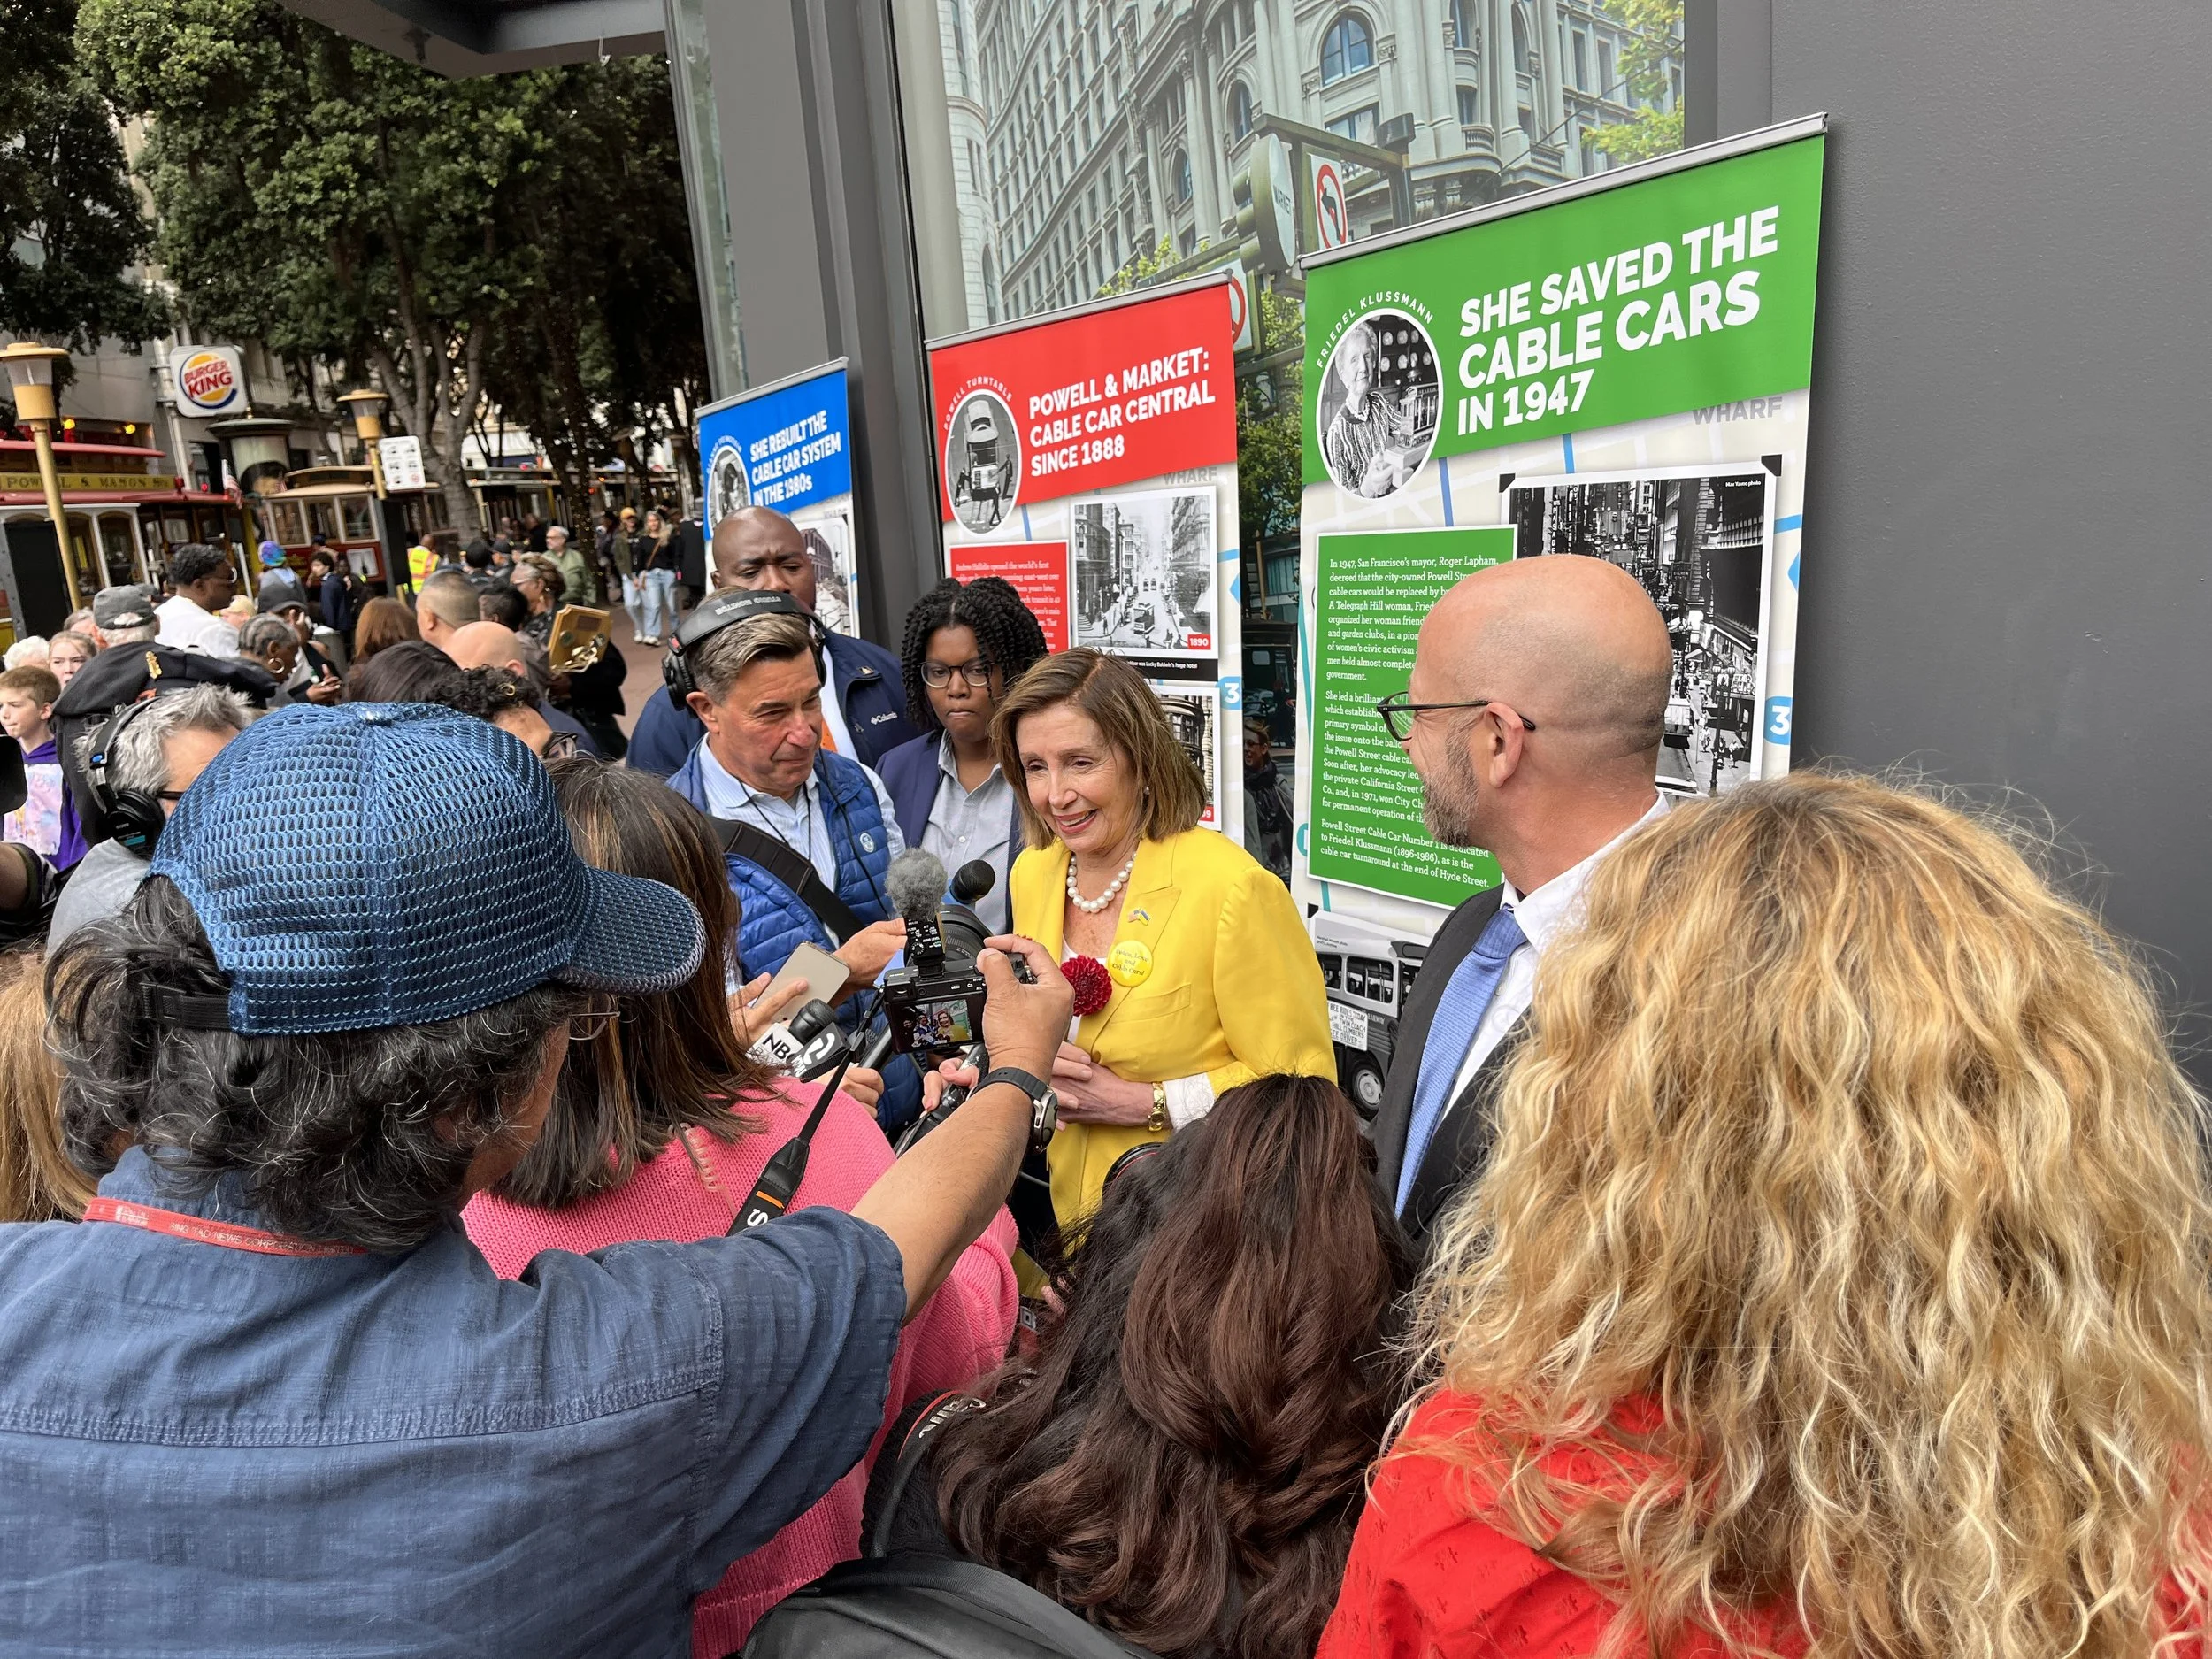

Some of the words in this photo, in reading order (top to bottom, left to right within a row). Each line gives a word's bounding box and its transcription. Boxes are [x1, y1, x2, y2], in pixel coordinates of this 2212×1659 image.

[1460, 281, 1531, 338] SHE
[1540, 242, 1673, 315] SAVED
[1682, 206, 1779, 274] THE
[1317, 309, 1356, 368] FRIEDEL
[1360, 291, 1433, 324] KLUSSMANN
[1458, 310, 1603, 388] CABLE
[1616, 270, 1760, 351] CARS
[184, 360, 228, 384] BURGER
[188, 372, 233, 398] KING
[1029, 379, 1102, 419] POWELL
[1104, 374, 1118, 398] &
[1123, 347, 1209, 394] MARKET:
[944, 388, 965, 430] POWELL
[966, 377, 1012, 402] TURNTABLE
[1458, 392, 1493, 435] IN
[1503, 369, 1594, 426] 1947
[1693, 397, 1782, 425] WHARF
[1030, 414, 1081, 448] CABLE
[1085, 404, 1123, 433] CAR
[1125, 380, 1216, 423] CENTRAL
[750, 438, 769, 462] SHE
[770, 419, 806, 456] REBUILT
[808, 410, 827, 436] THE
[753, 458, 782, 486] CABLE
[782, 449, 801, 473] CAR
[802, 432, 841, 465] SYSTEM
[1031, 445, 1078, 477] SINCE
[1081, 434, 1125, 465] 1888
[1164, 468, 1217, 485] WHARF
[753, 488, 764, 506] IN
[764, 481, 785, 505] THE
[785, 473, 812, 498] 1980s
[1330, 559, 1337, 568] In
[1340, 560, 1356, 569] 1947,
[1371, 557, 1409, 567] Francisco's
[1411, 558, 1437, 570] mayor,
[1439, 557, 1462, 568] Roger
[1330, 573, 1356, 582] decreed
[1372, 572, 1383, 581] the
[1385, 572, 1425, 583] city-owned
[1427, 572, 1453, 580] Powell
[1329, 588, 1348, 596] cable
[1396, 588, 1427, 600] replaced
[1430, 587, 1439, 597] by
[1336, 601, 1368, 611] Telegraph
[1385, 603, 1413, 612] woman,
[1328, 617, 1360, 626] organized
[1328, 628, 1340, 637] and
[1342, 630, 1363, 639] garden
[1365, 629, 1386, 640] clubs,
[1364, 644, 1381, 653] civic
[1357, 657, 1380, 667] almost
[1327, 671, 1366, 680] government.
[1225, 683, 1240, 703] 3
[1326, 690, 1337, 700] She
[1339, 692, 1348, 701] led
[1355, 694, 1384, 703] brilliant
[1325, 705, 1344, 714] which
[1325, 719, 1349, 729] primary
[1351, 723, 1377, 733] symbol
[1379, 724, 1387, 733] of
[1770, 705, 1791, 736] 3
[1335, 733, 1352, 742] issue
[1372, 738, 1383, 747] the
[1335, 746, 1356, 757] Powell
[1359, 749, 1380, 760] Street
[1382, 752, 1401, 763] cable
[1324, 759, 1339, 768] Soon
[1340, 761, 1358, 772] after,
[1360, 763, 1372, 772] her
[1374, 767, 1406, 779] advocacy
[1334, 775, 1358, 787] private
[1361, 778, 1394, 790] California
[1396, 784, 1419, 795] Street
[1323, 786, 1334, 795] Co.,
[1336, 789, 1350, 799] and,
[1352, 790, 1359, 799] in
[1361, 792, 1379, 803] 1971,
[1395, 796, 1409, 809] City
[1333, 802, 1371, 814] permanent
[1372, 808, 1405, 821] operation
[1407, 810, 1415, 821] of
[1322, 819, 1342, 831] Powell
[1345, 824, 1366, 835] Street
[1368, 827, 1386, 839] Cable
[1388, 831, 1401, 841] Car
[1402, 834, 1433, 848] Number
[1329, 834, 1353, 846] Friedel
[1356, 839, 1392, 854] Klussmann
[1394, 846, 1440, 864] (1896-1986),
[1442, 856, 1450, 865] as
[1452, 857, 1459, 867] is
[1461, 859, 1473, 870] the
[1321, 847, 1338, 856] cable
[1340, 850, 1351, 859] car
[1353, 853, 1390, 867] turnaround
[1401, 861, 1413, 872] the
[1415, 865, 1428, 877] end
[1431, 867, 1439, 879] of
[1440, 870, 1460, 882] Hyde
[1463, 874, 1489, 887] Street.
